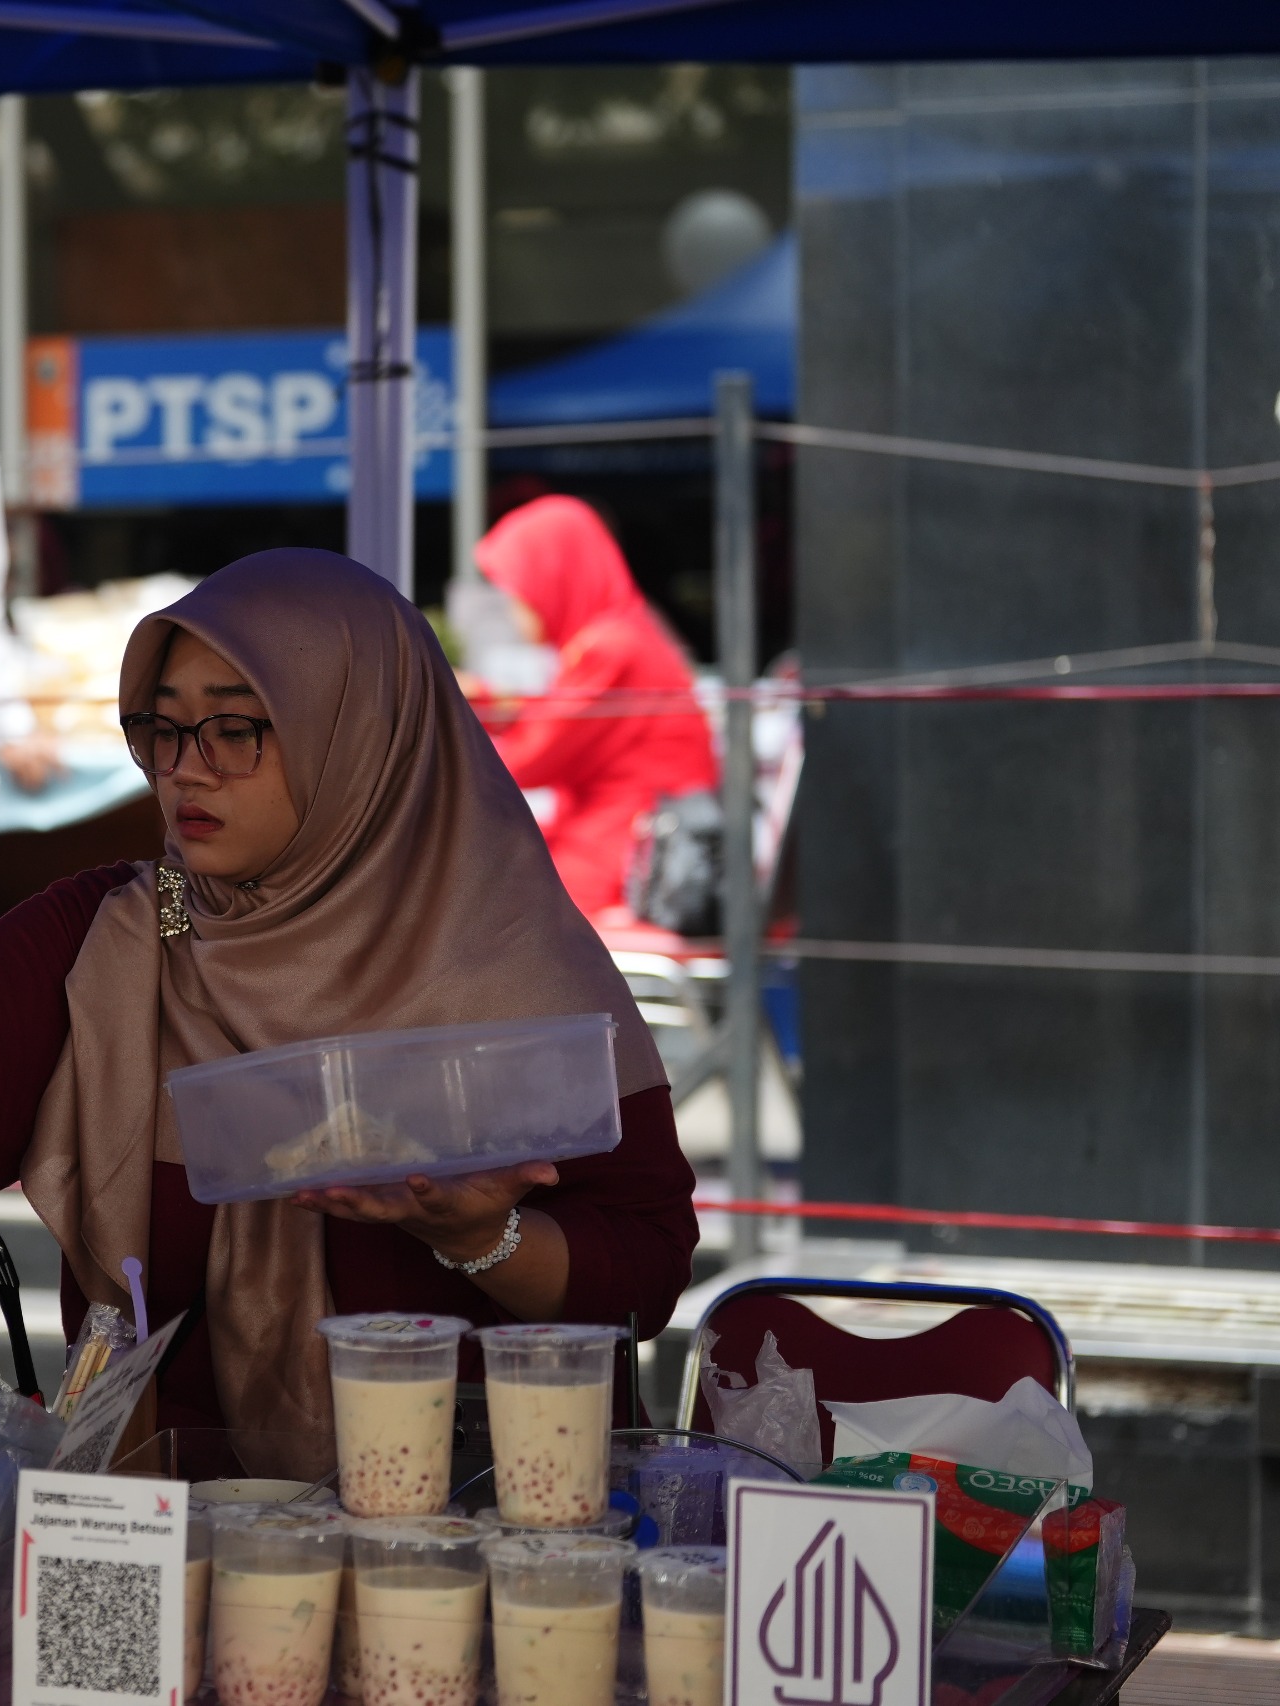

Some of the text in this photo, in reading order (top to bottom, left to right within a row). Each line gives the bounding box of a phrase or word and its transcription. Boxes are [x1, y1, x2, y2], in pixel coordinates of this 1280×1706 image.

[84, 371, 339, 464] PTSP
[858, 1471, 885, 1483] 30%
[30, 1513, 174, 1536] Jajanan Warung Betsun
